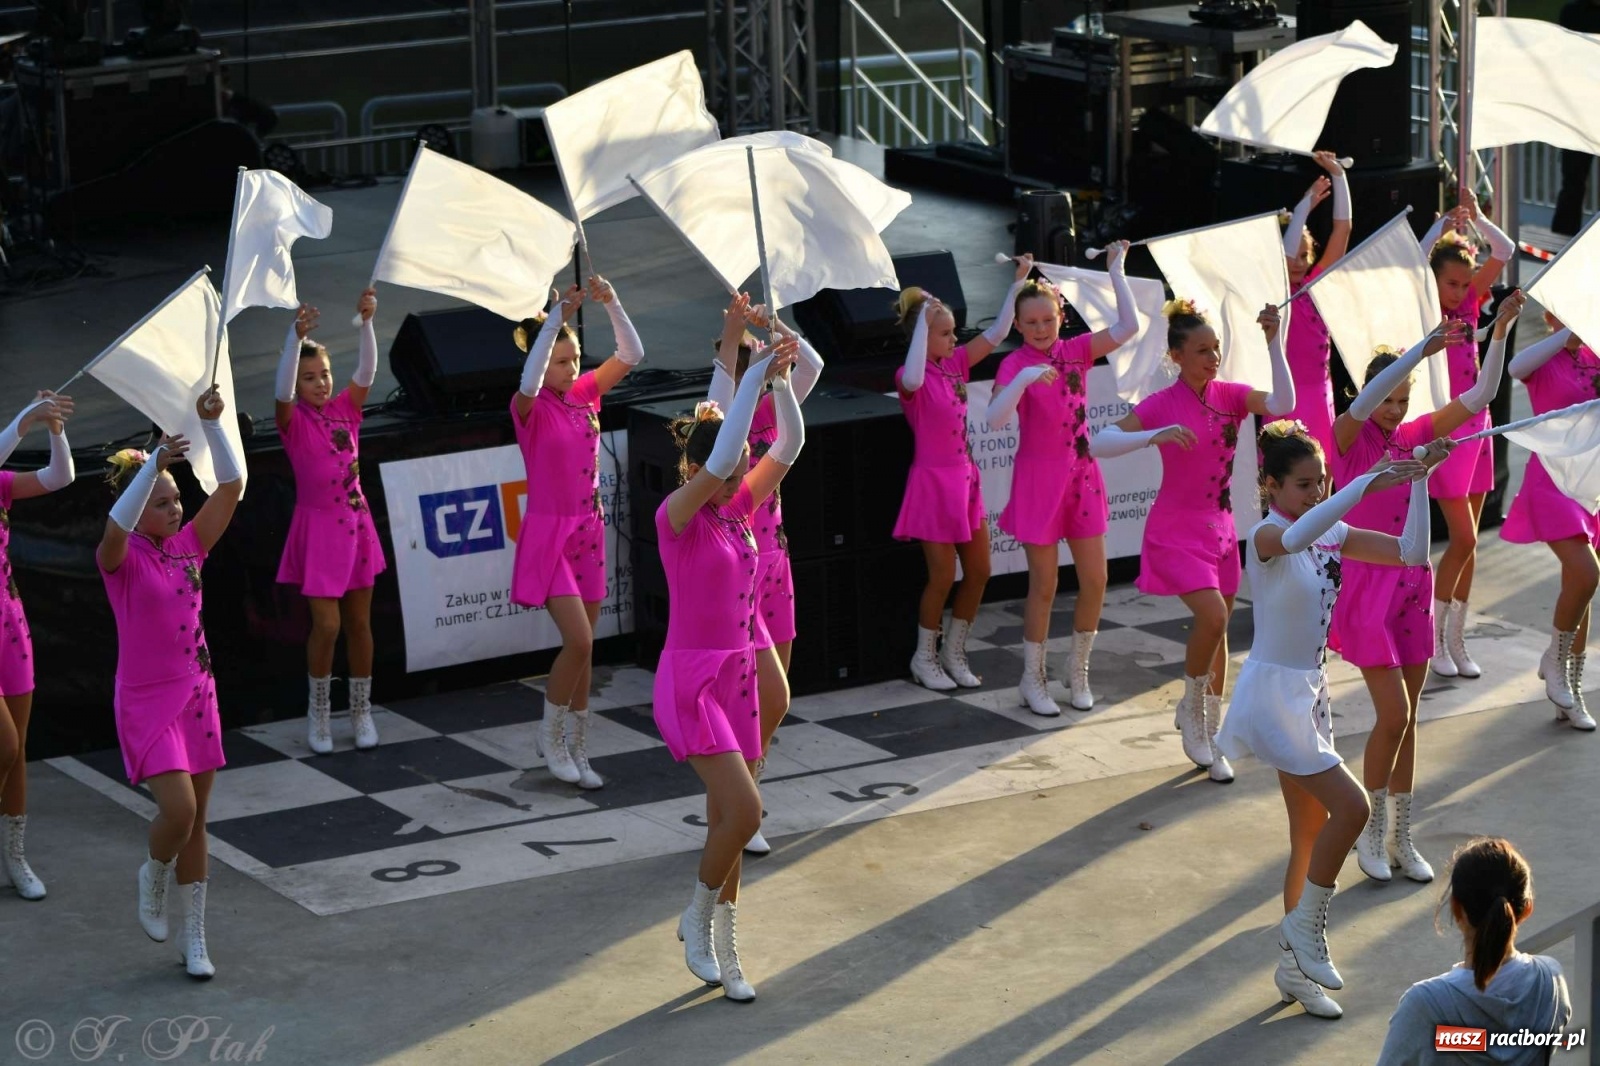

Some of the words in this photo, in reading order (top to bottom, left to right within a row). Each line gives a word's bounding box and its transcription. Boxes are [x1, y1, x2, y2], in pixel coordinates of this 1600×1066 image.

[980, 436, 1017, 452] FOND
[435, 499, 494, 544] CZ
[445, 591, 488, 609] Zakup
[490, 589, 502, 601] w
[435, 610, 483, 629] numer:
[829, 782, 920, 803] 5
[520, 837, 618, 858] 7
[370, 859, 462, 883] 8
